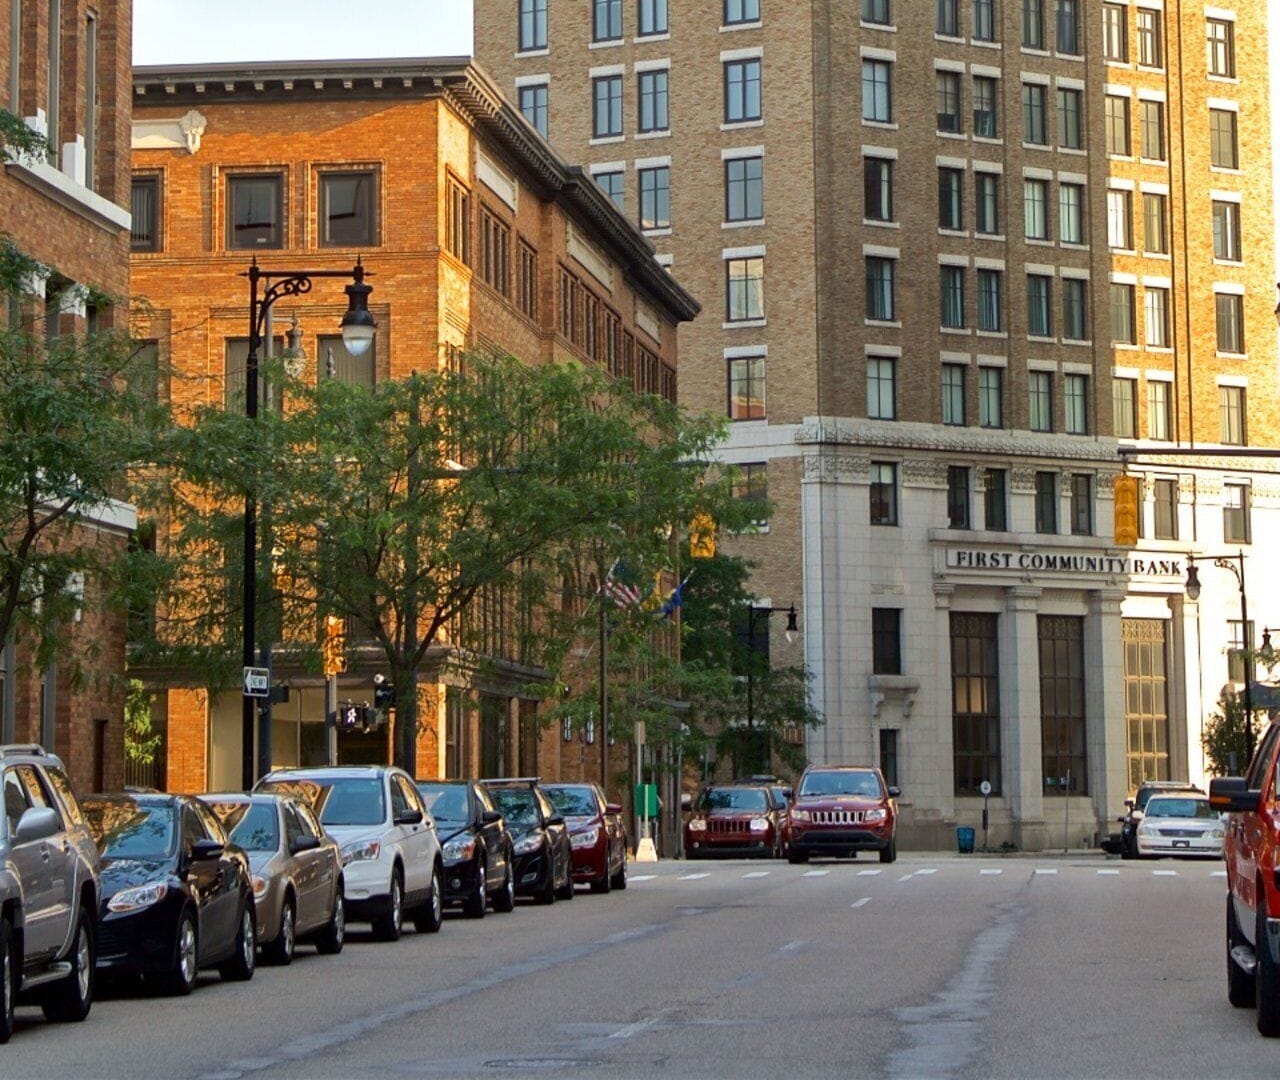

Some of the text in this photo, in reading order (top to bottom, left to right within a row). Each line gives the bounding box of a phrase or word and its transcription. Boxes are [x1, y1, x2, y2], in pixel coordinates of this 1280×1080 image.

[956, 551, 1181, 575] FIRST COMMUNITY BANK
